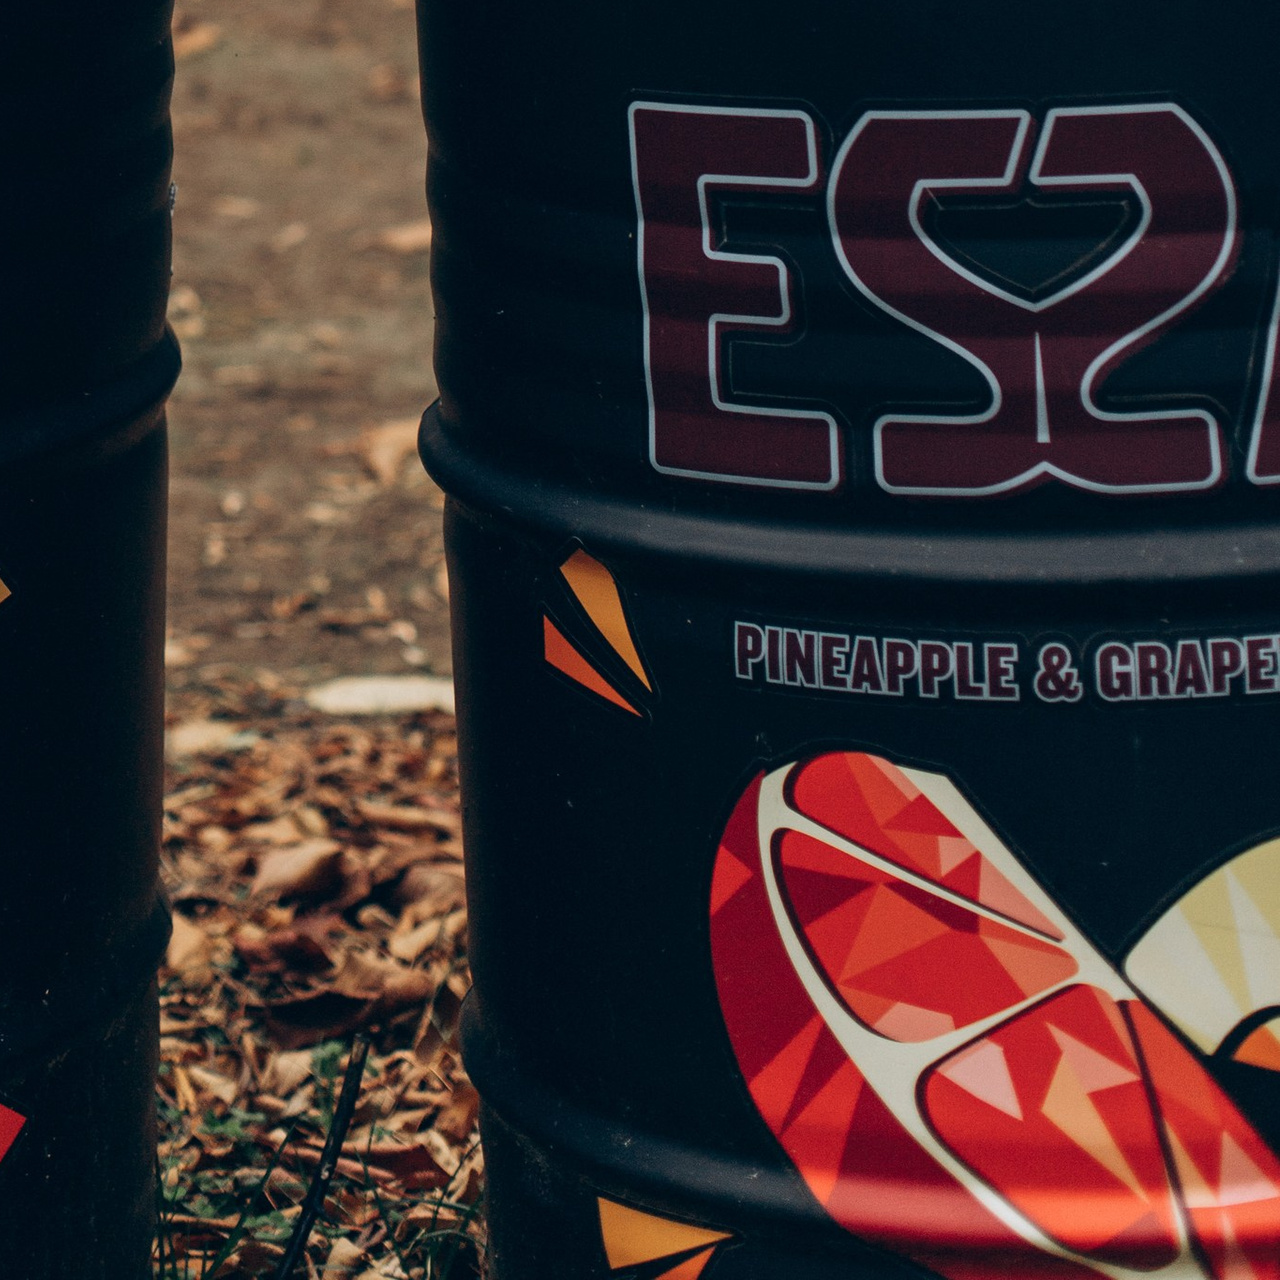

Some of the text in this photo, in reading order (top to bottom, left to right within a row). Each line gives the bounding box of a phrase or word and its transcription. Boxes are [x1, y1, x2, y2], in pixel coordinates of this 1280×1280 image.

[628, 100, 1280, 497] ESS
[734, 620, 1280, 703] PINEAPPLE & GRAPE
